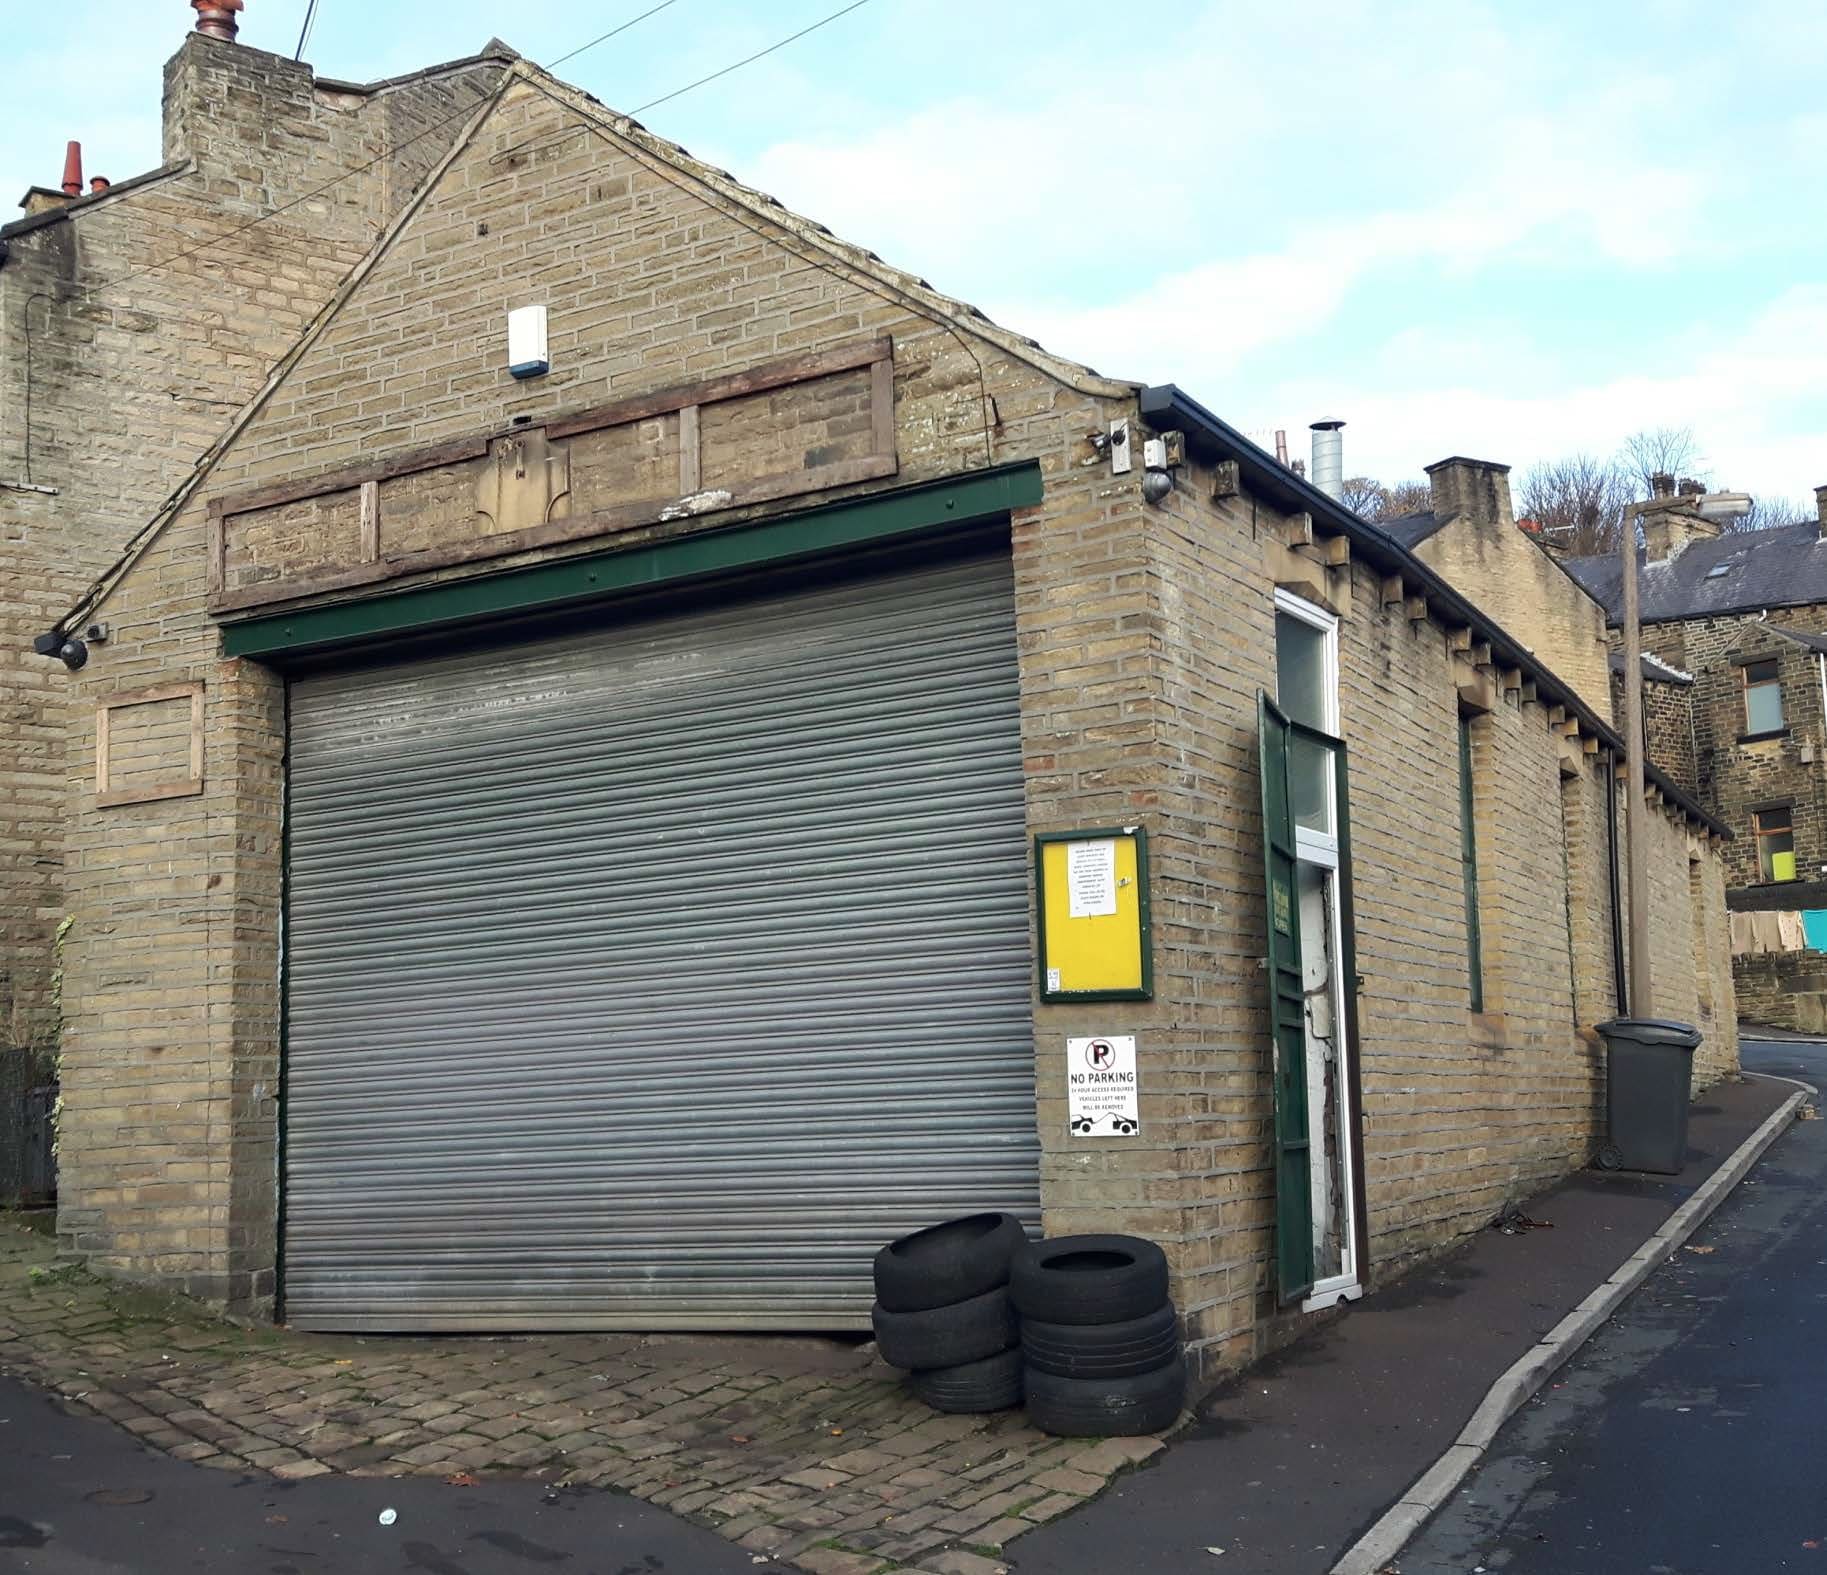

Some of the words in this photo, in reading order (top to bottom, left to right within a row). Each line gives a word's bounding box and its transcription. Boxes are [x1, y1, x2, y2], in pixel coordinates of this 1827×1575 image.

[1094, 1045, 1109, 1064] P
[1071, 1073, 1085, 1084] NO
[1088, 1072, 1134, 1084] PARKING
